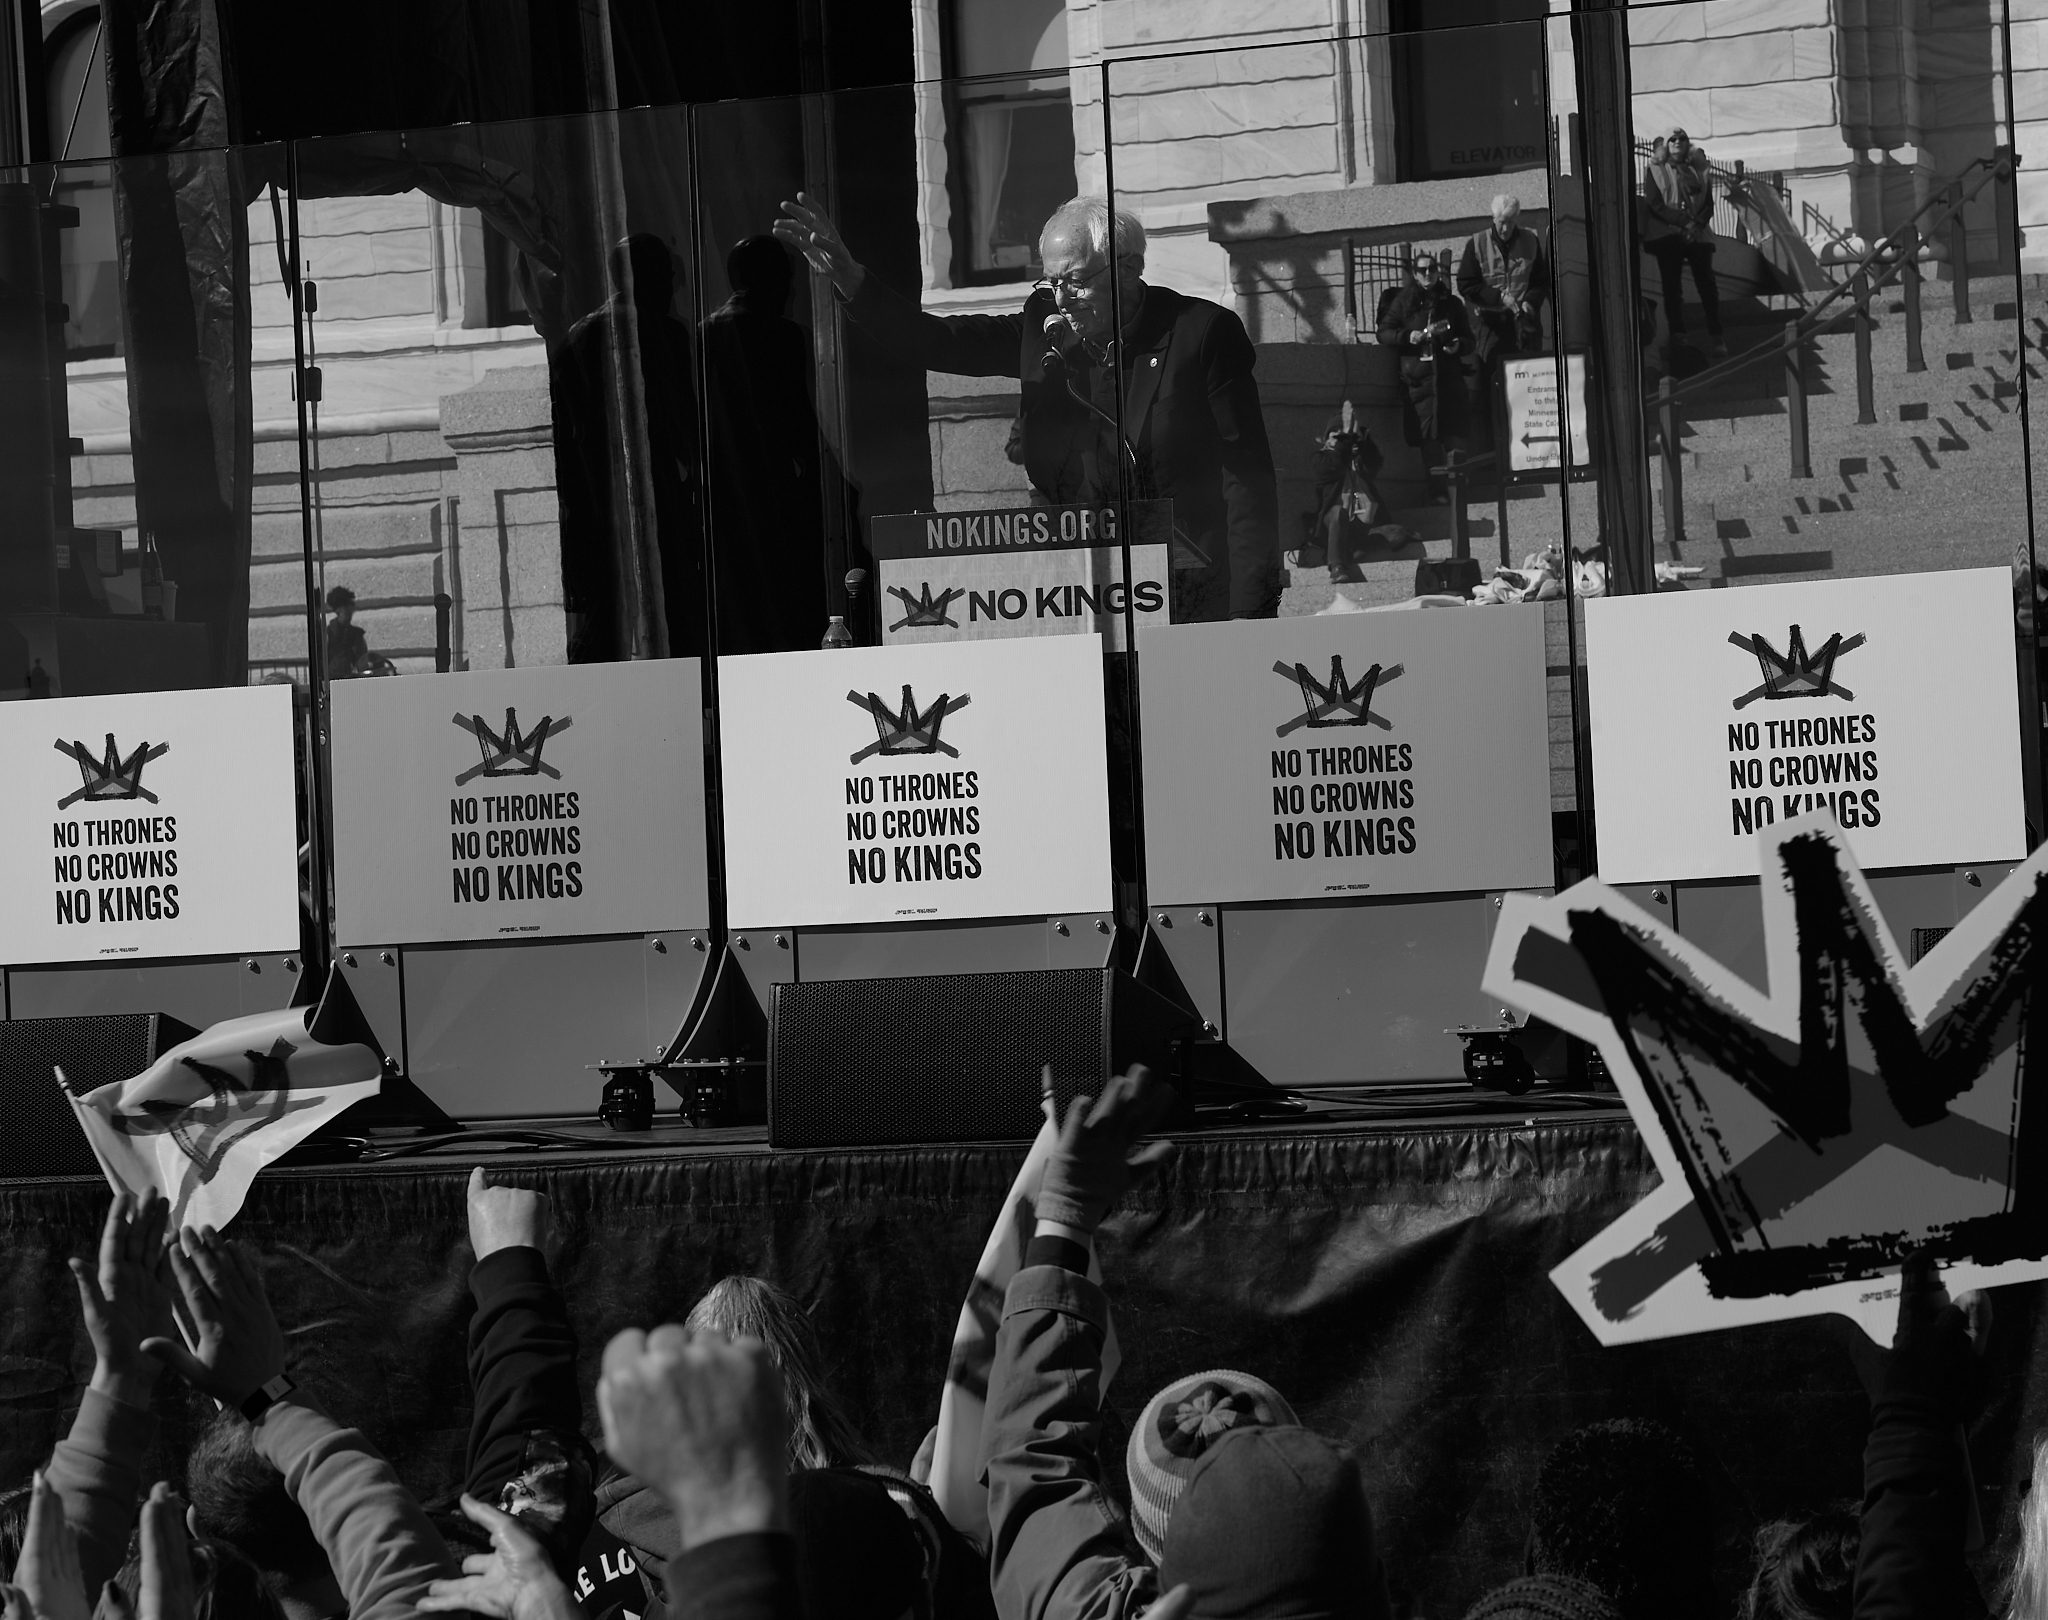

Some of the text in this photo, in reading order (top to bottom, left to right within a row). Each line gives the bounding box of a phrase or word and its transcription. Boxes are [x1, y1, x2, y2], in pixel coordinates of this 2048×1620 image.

[1450, 145, 1536, 165] ELEVATOR
[1534, 397, 1542, 405] to
[1524, 420, 1543, 429] State
[1526, 455, 1549, 463] Under
[926, 508, 1117, 549] NOKINGS.ORG
[969, 581, 1164, 622] NO KINGS
[1728, 714, 1877, 752] NO THRONES
[1272, 744, 1413, 778] NO THRONES
[1730, 751, 1879, 790] NO CROWNS
[846, 771, 979, 804] NO THRONES
[1273, 779, 1415, 815] NO CROWNS
[451, 792, 580, 825] NO THRONES
[847, 806, 980, 841] NO CROWNS
[1732, 794, 1775, 836] NO
[54, 816, 177, 849] NO THRONES
[452, 826, 581, 861] NO CROWNS
[1275, 816, 1417, 861] NO KINGS
[55, 850, 178, 883] NO CROWNS
[849, 842, 982, 885] NO KINGS
[453, 862, 583, 904] NO KINGS
[56, 884, 180, 925] NO KINGS
